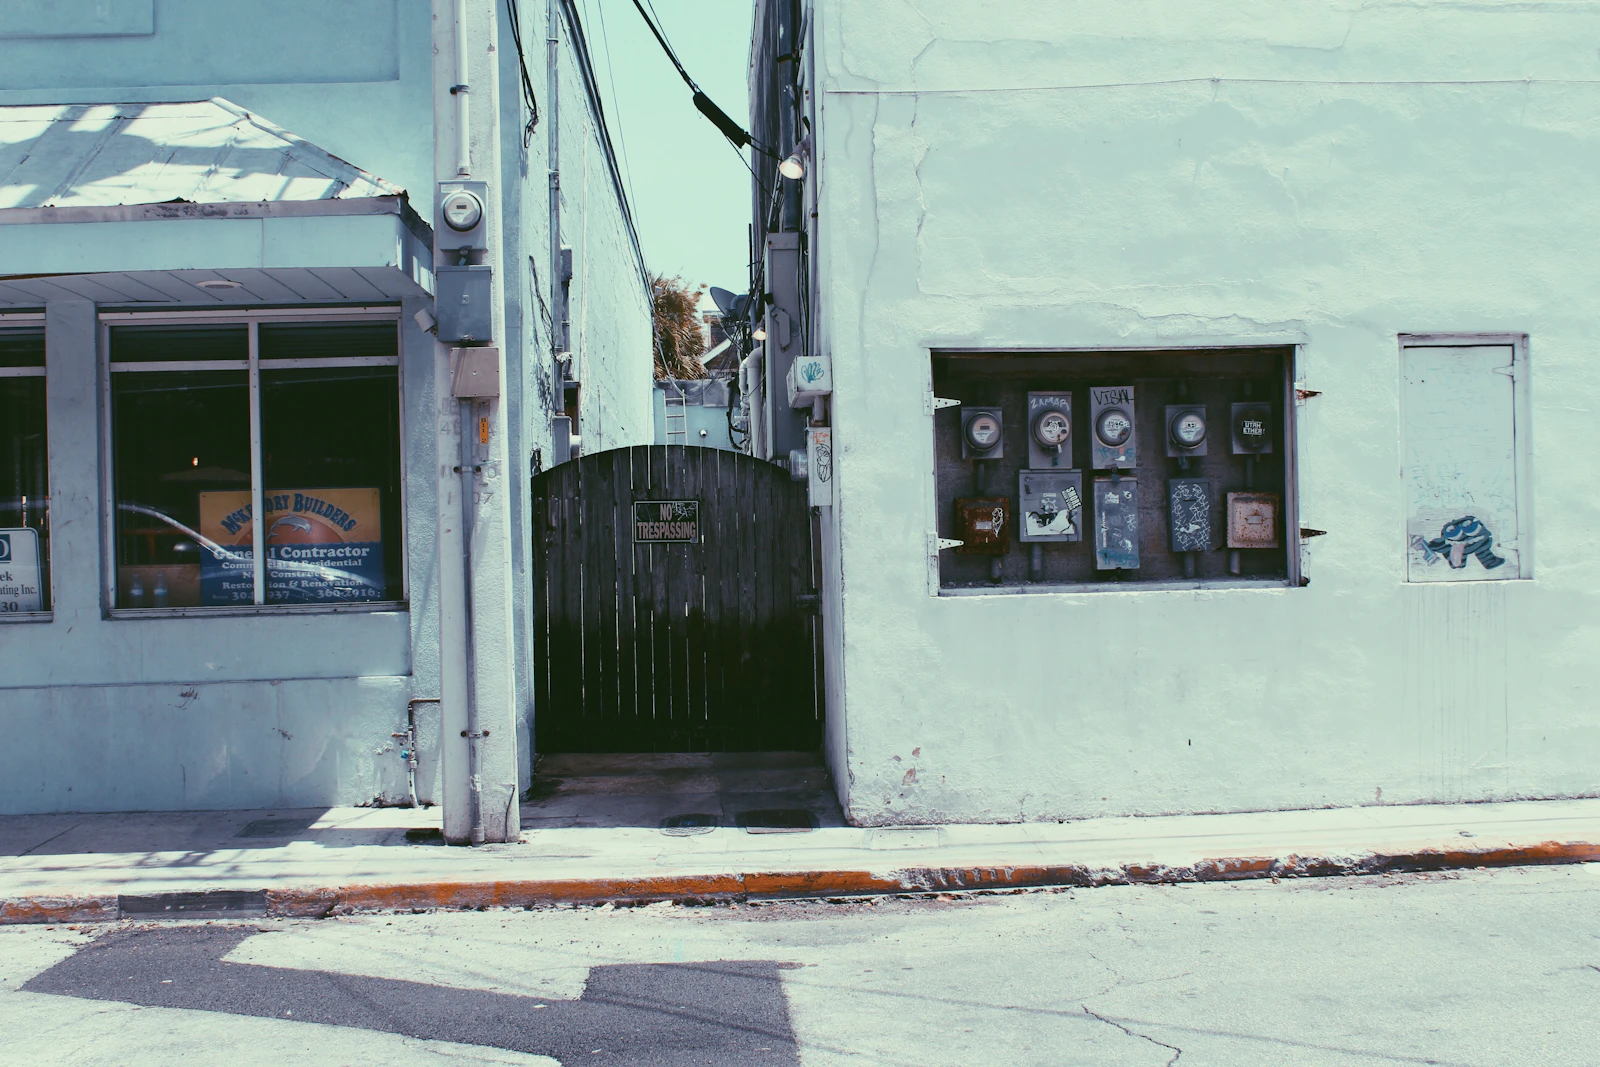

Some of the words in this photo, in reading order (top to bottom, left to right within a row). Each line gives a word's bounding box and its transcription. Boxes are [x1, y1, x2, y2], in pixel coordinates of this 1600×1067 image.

[292, 492, 357, 532] BUILDERS
[660, 503, 673, 521] NO
[637, 521, 696, 539] TRESPASSING
[213, 547, 276, 560] Genel
[281, 546, 370, 558] Contractor
[221, 560, 286, 569] Commcial
[21, 584, 37, 595] Inc.
[222, 580, 286, 590] Restoion
[301, 579, 363, 588] Renovation
